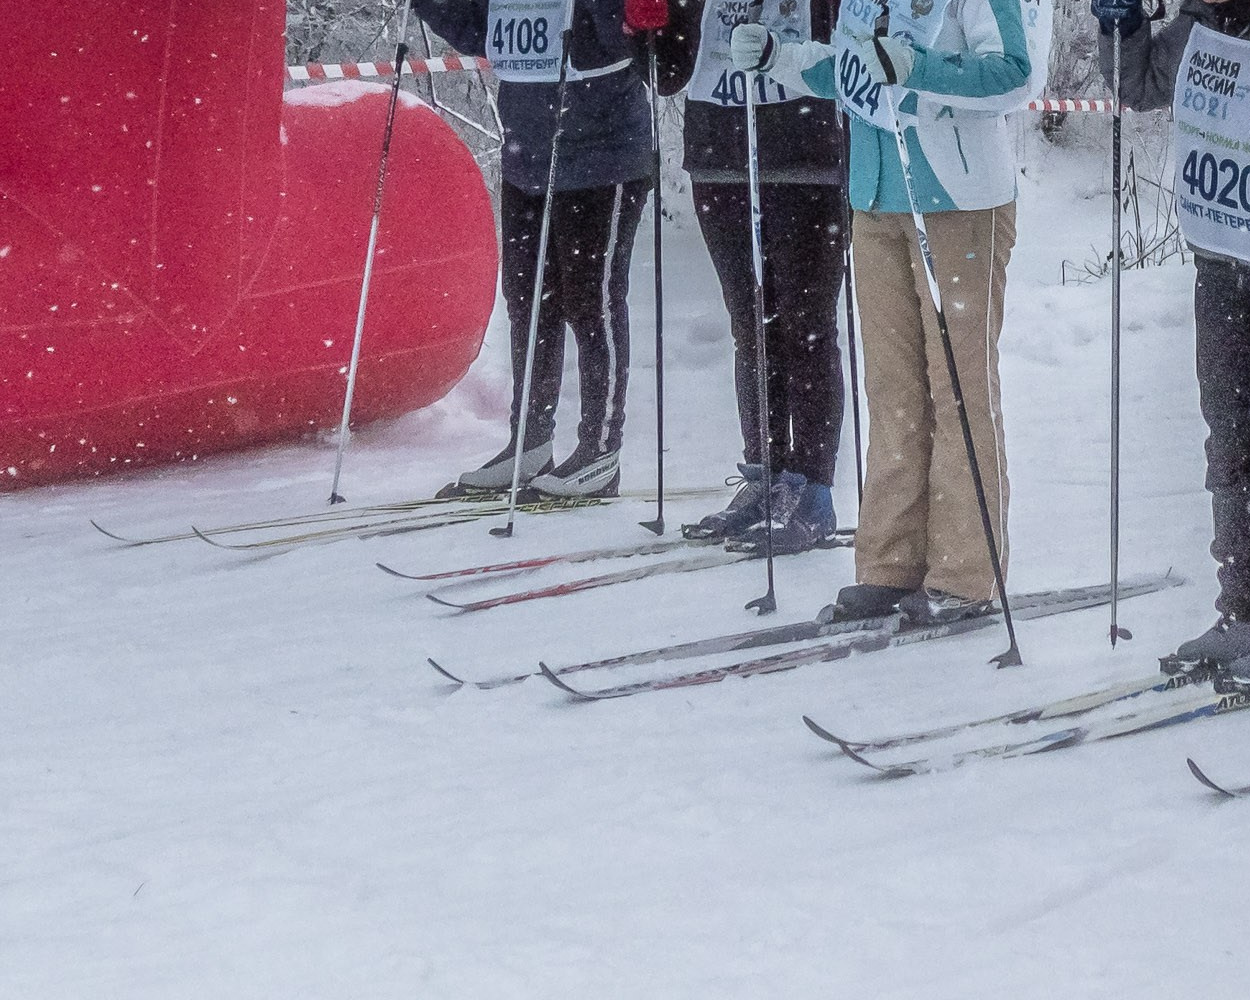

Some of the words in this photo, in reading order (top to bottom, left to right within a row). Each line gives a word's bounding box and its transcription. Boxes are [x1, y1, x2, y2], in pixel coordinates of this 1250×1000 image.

[492, 16, 548, 55] 4108
[1189, 50, 1241, 79] ЛЫЖНЯ
[1186, 66, 1236, 98] РОССИИ
[1181, 87, 1228, 120] 2021
